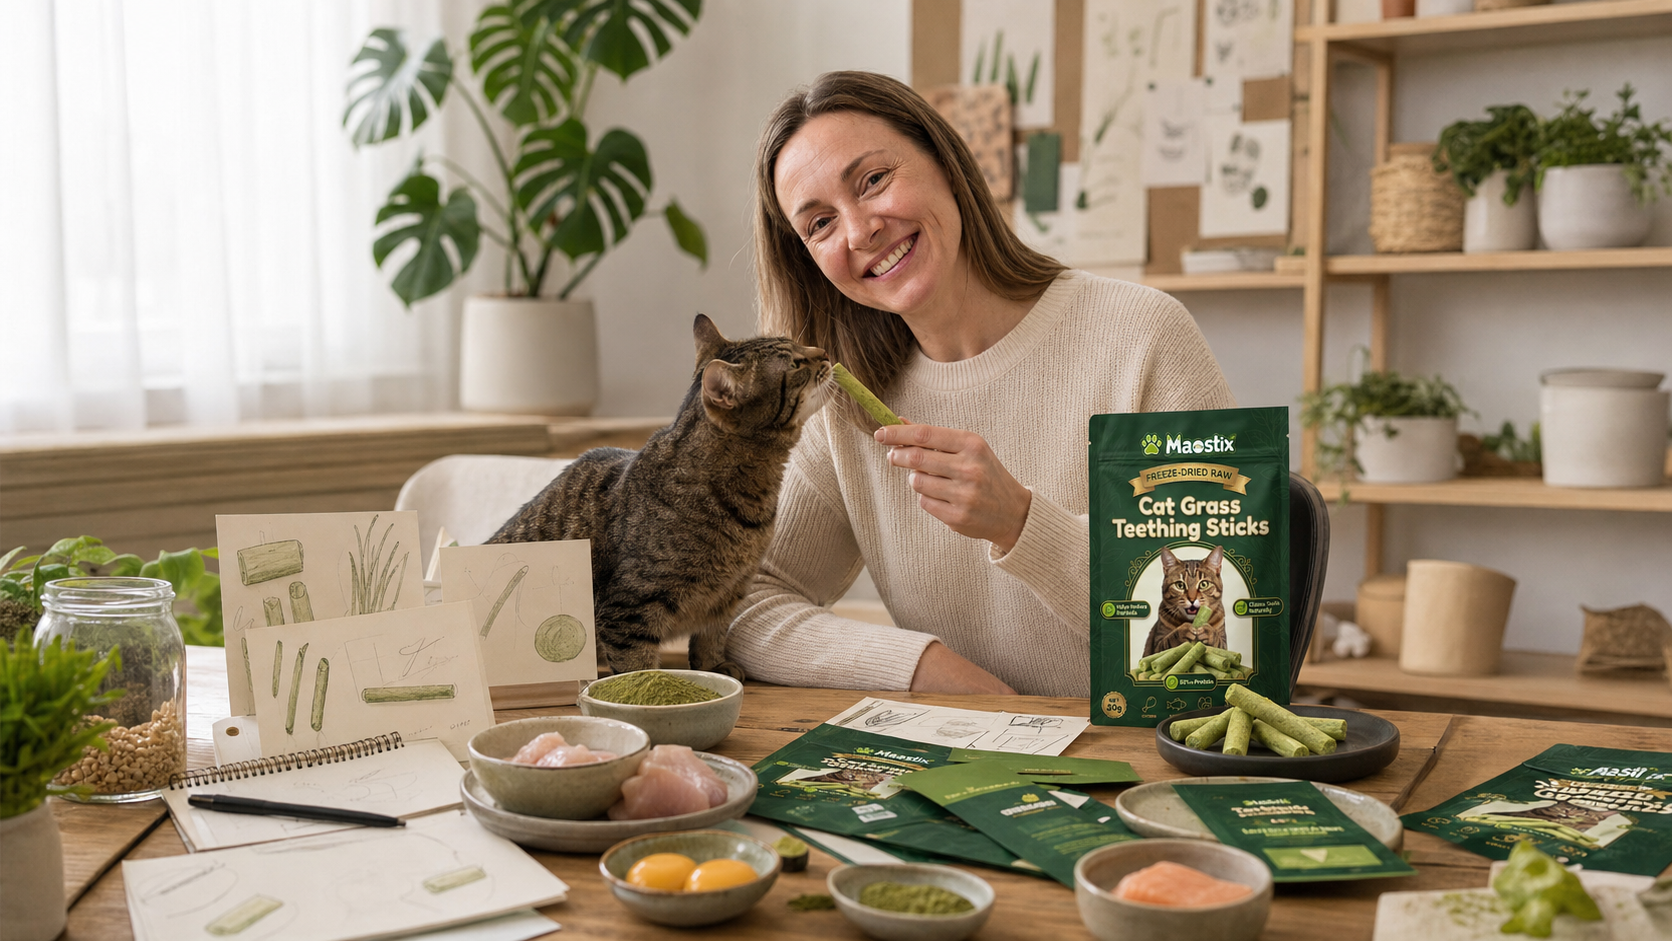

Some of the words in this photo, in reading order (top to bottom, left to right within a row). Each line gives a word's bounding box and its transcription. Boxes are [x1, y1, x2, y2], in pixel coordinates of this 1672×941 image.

[1166, 434, 1235, 454] Maostix
[1146, 468, 1208, 482] FREEZE-DRIED
[1211, 469, 1233, 480] RAW
[1138, 496, 1176, 516] Cat
[1180, 496, 1241, 516] Grass
[1112, 518, 1201, 542] Teething
[1206, 515, 1270, 537] Sticks
